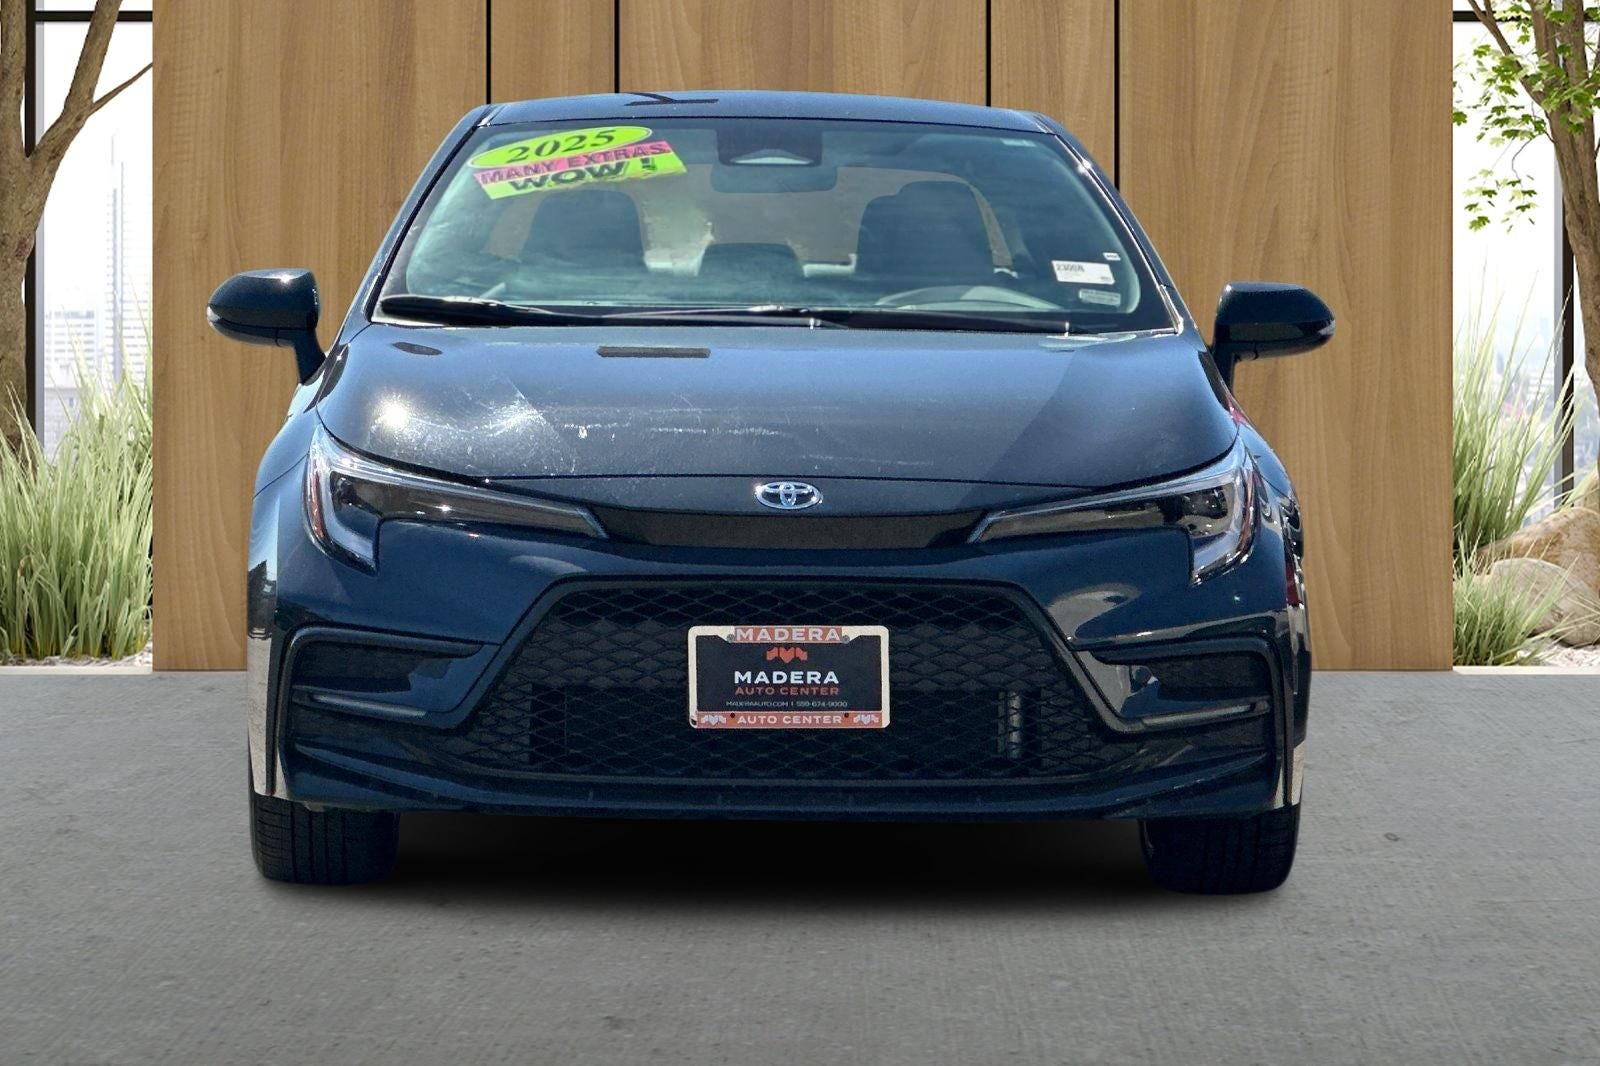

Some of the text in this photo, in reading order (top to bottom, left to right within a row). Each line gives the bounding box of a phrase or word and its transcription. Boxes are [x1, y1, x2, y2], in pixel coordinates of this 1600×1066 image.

[508, 130, 616, 163] 2025
[480, 142, 671, 184] MANY EXTRAS
[736, 628, 841, 641] MADERA
[734, 671, 839, 684] MADERA
[735, 686, 839, 696] AUTO CENTER
[737, 715, 842, 724] AUTO CENTER
